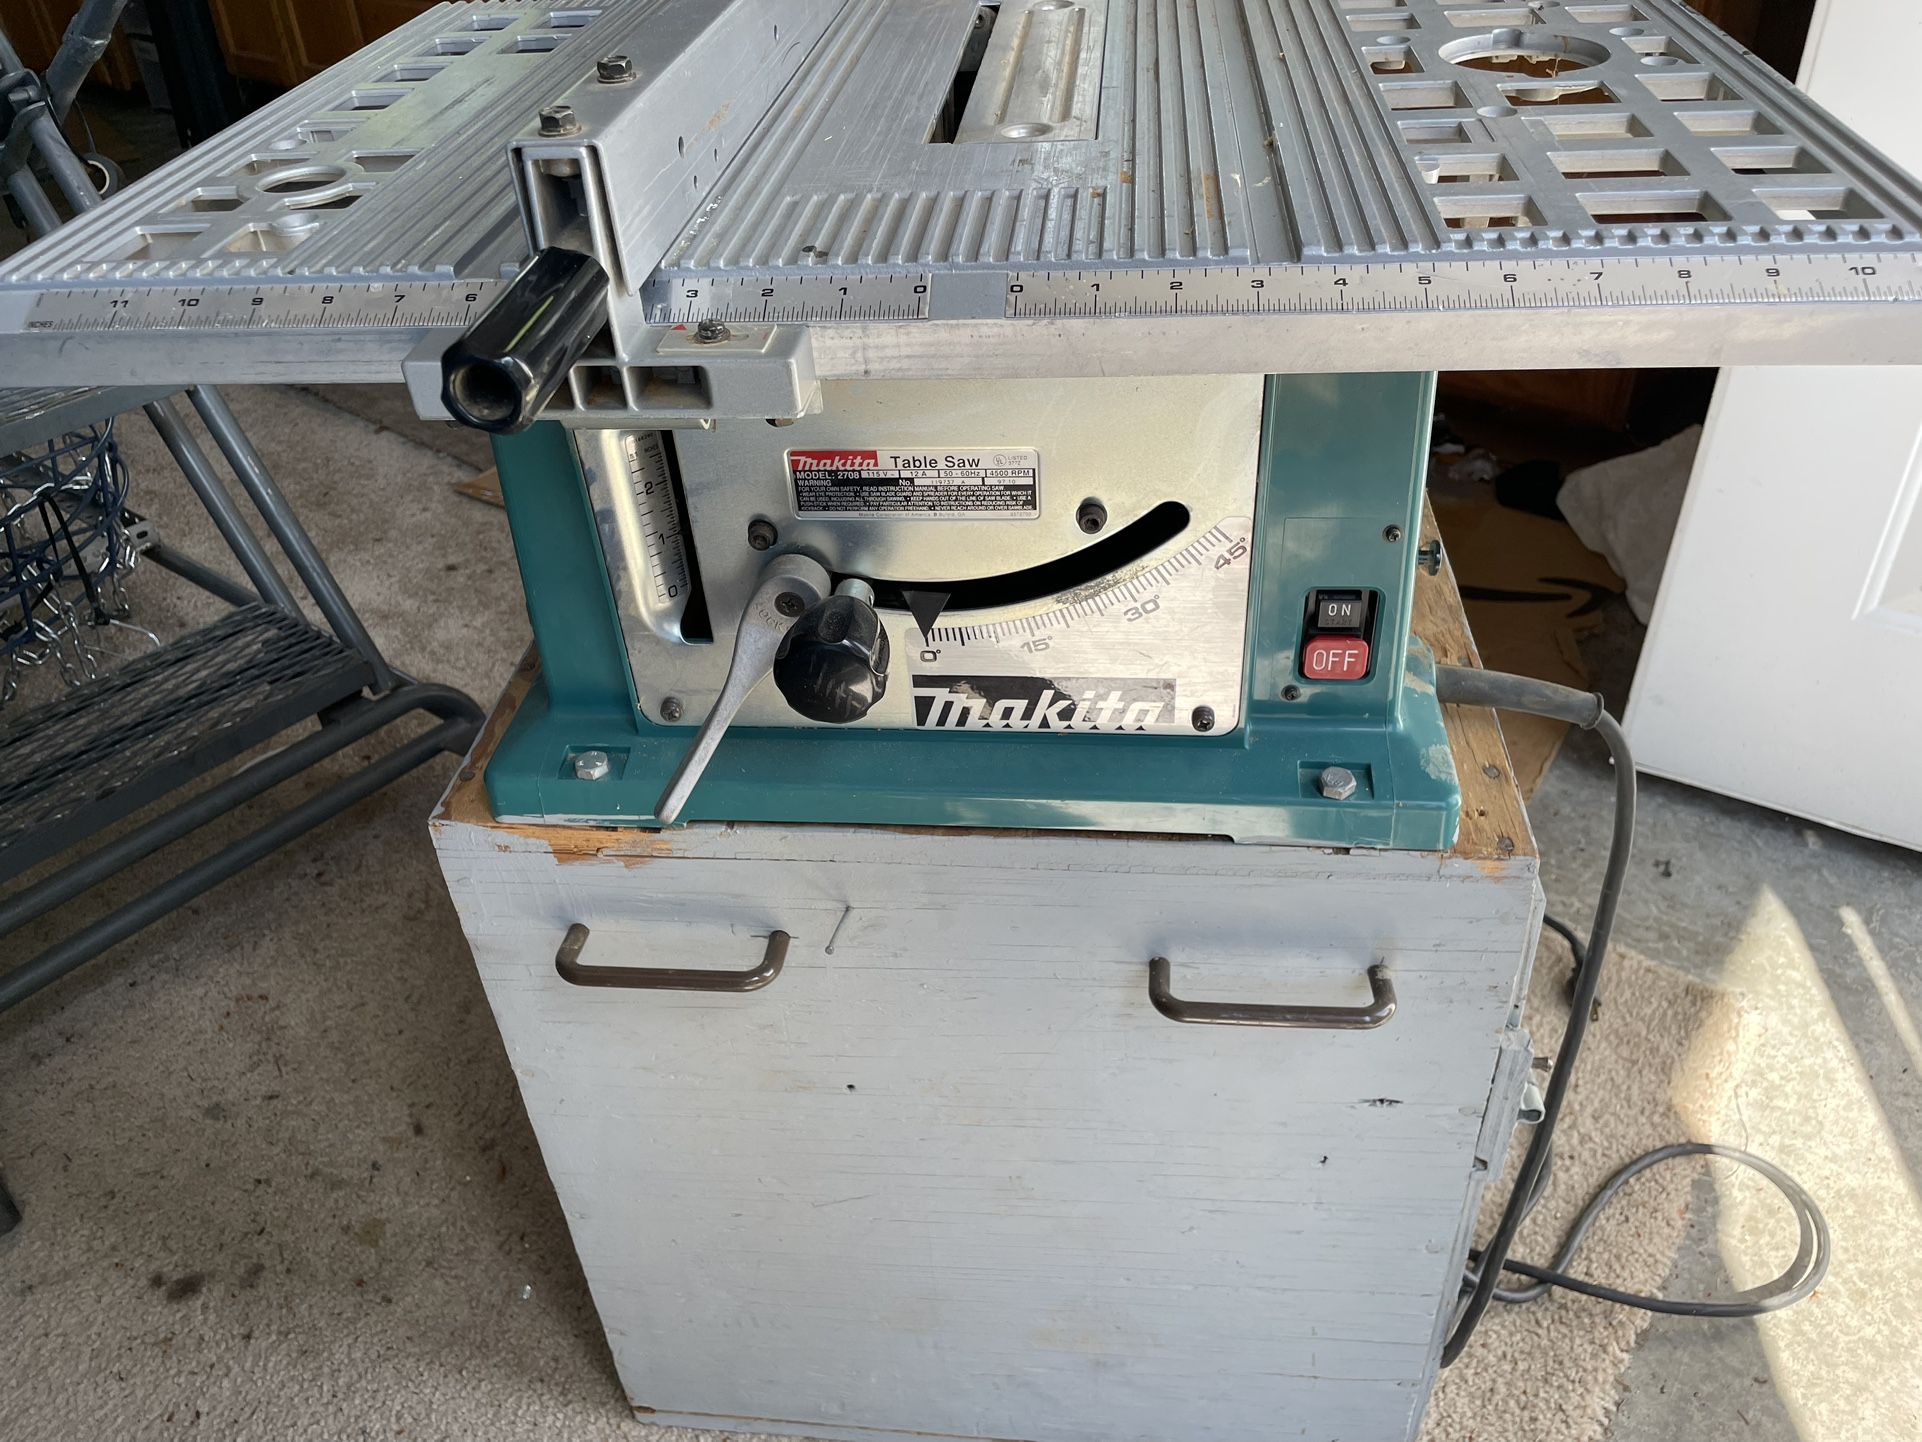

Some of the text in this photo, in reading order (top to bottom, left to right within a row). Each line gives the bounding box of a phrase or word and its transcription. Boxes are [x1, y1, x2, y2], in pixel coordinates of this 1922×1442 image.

[1010, 266, 1877, 294] 0 1 2 3 4 5 6 7 8 9 10
[110, 284, 927, 308] 11 10 9 8 7 6 3 2 1 0
[890, 455, 980, 468] Table Saw
[644, 480, 654, 496] 2
[658, 533, 665, 545] 1
[668, 584, 678, 598] 0
[1328, 604, 1352, 616] ON
[1312, 650, 1359, 672] OFF
